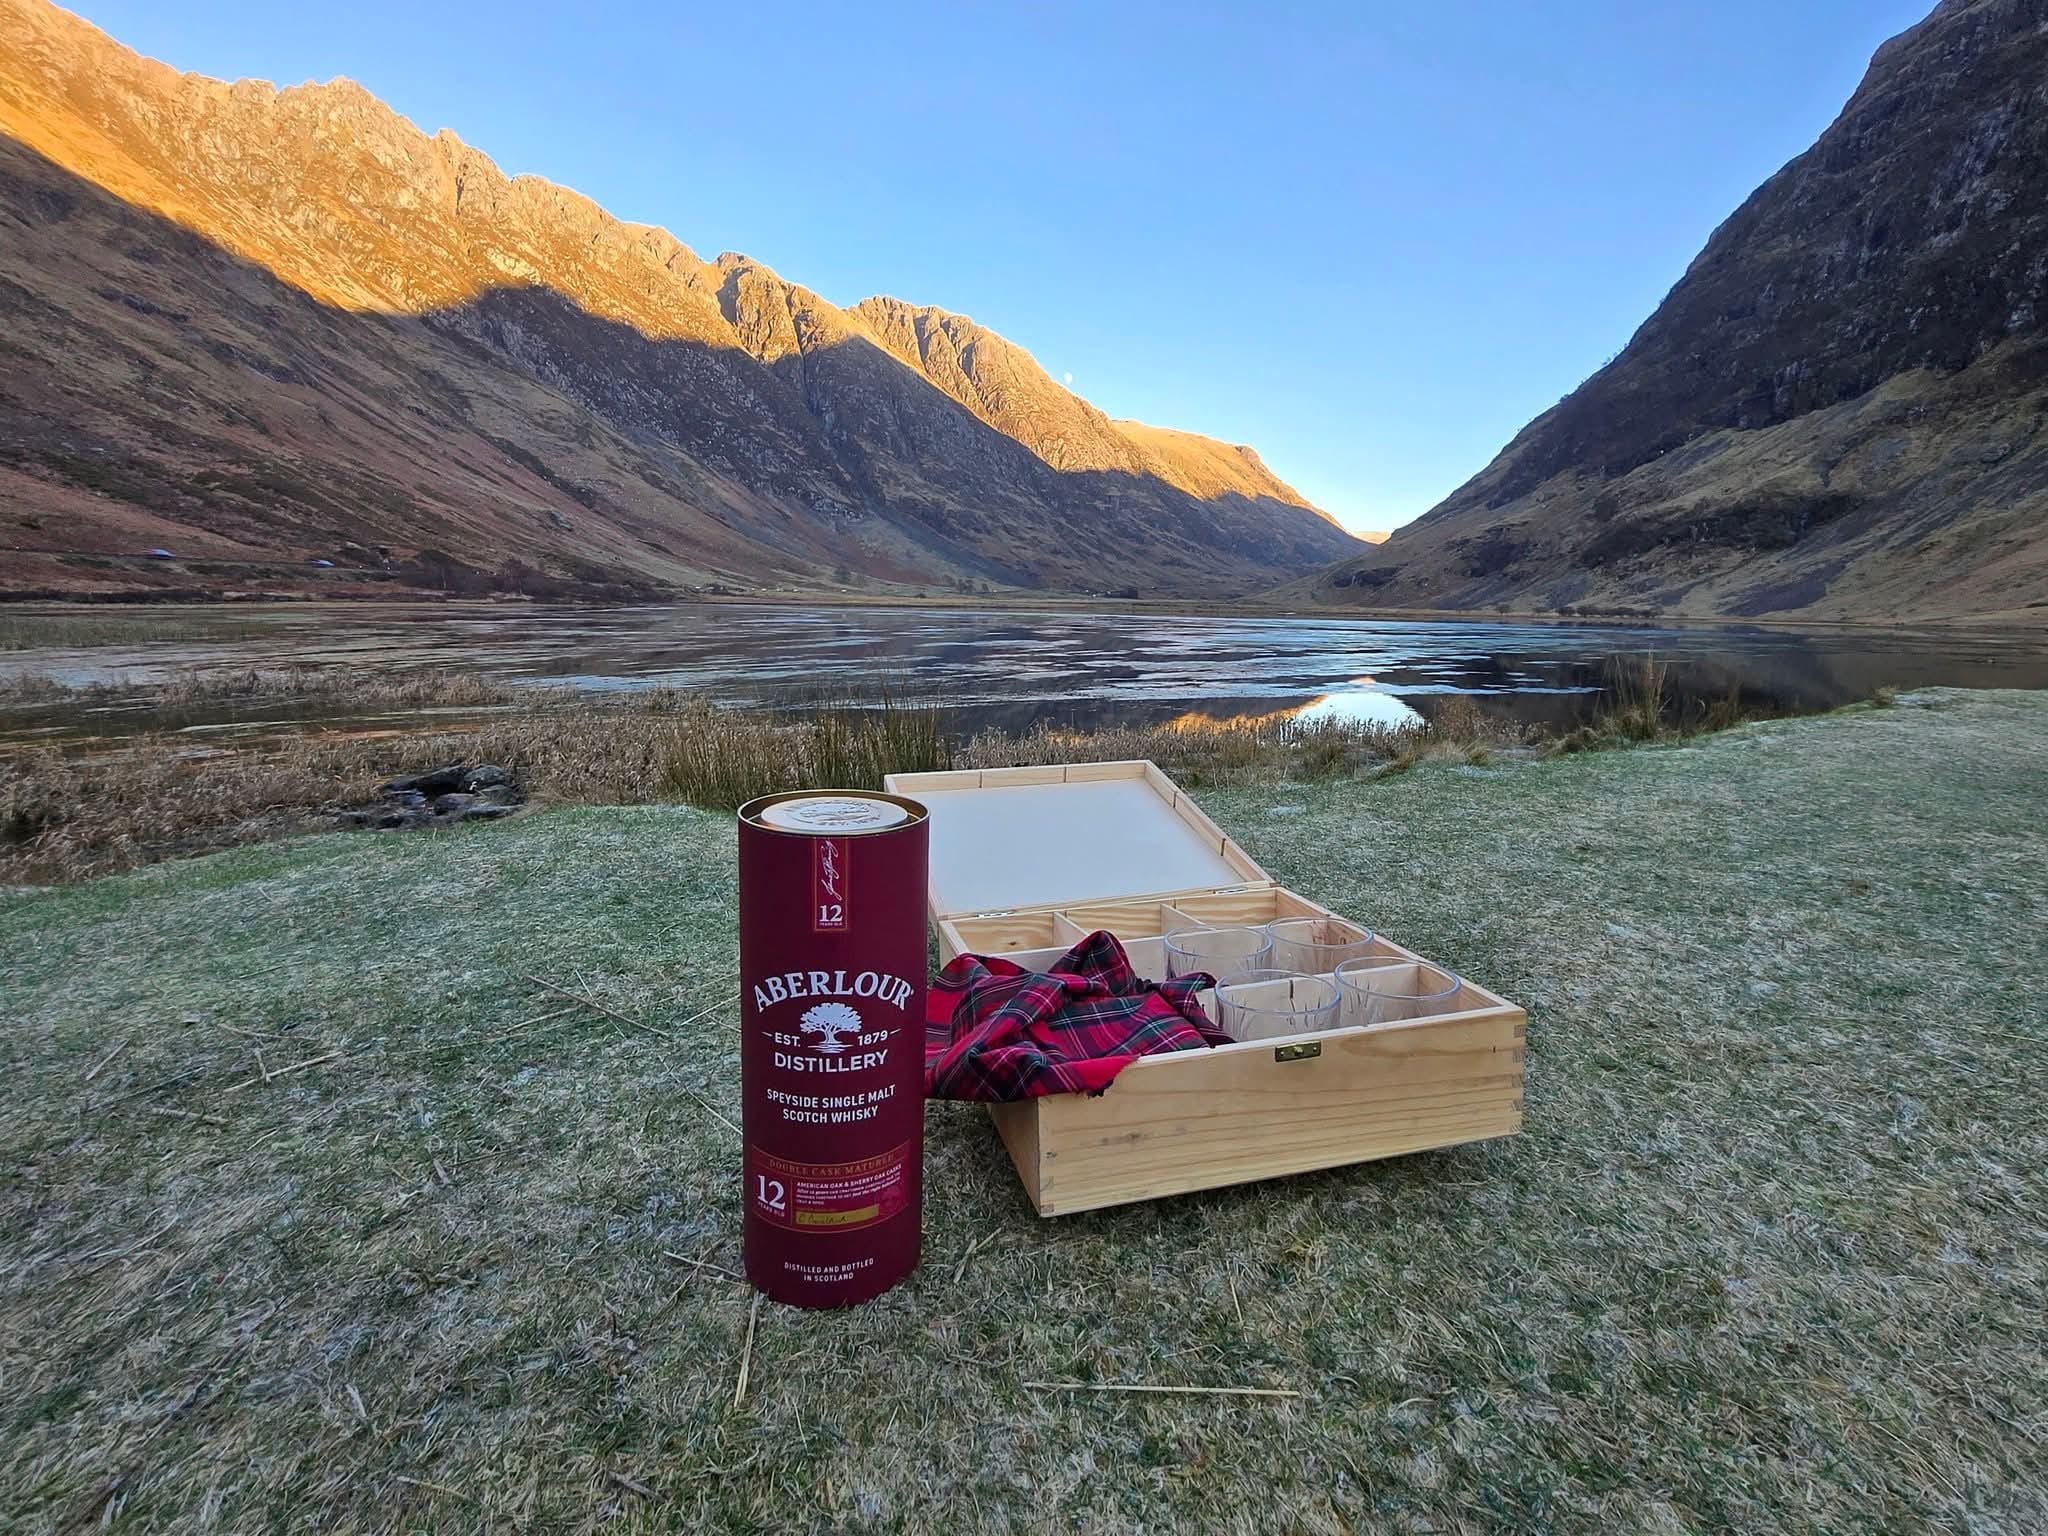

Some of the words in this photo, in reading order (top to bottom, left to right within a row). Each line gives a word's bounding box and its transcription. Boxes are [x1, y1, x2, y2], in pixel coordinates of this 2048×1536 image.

[819, 904, 843, 922] 12
[754, 970, 914, 1013] ABERLOUR
[774, 1032, 801, 1047] EST.
[857, 1030, 888, 1046] 1879
[774, 1049, 888, 1073] DISTILLERY
[767, 1088, 818, 1109] SPEYSIDE
[822, 1093, 865, 1109] SINGLE
[868, 1084, 896, 1103] MALT
[783, 1108, 828, 1123] SCOTCH
[831, 1105, 879, 1123] WHISKY
[769, 1159, 809, 1176] DOUBLE
[811, 1166, 842, 1177] CASK
[757, 1174, 786, 1210] 12
[784, 1261, 822, 1274] DISTILLED
[824, 1266, 840, 1274] AND
[842, 1257, 874, 1273] BOTTLED
[804, 1274, 812, 1282] IN
[814, 1272, 854, 1283] SCOTLAND
